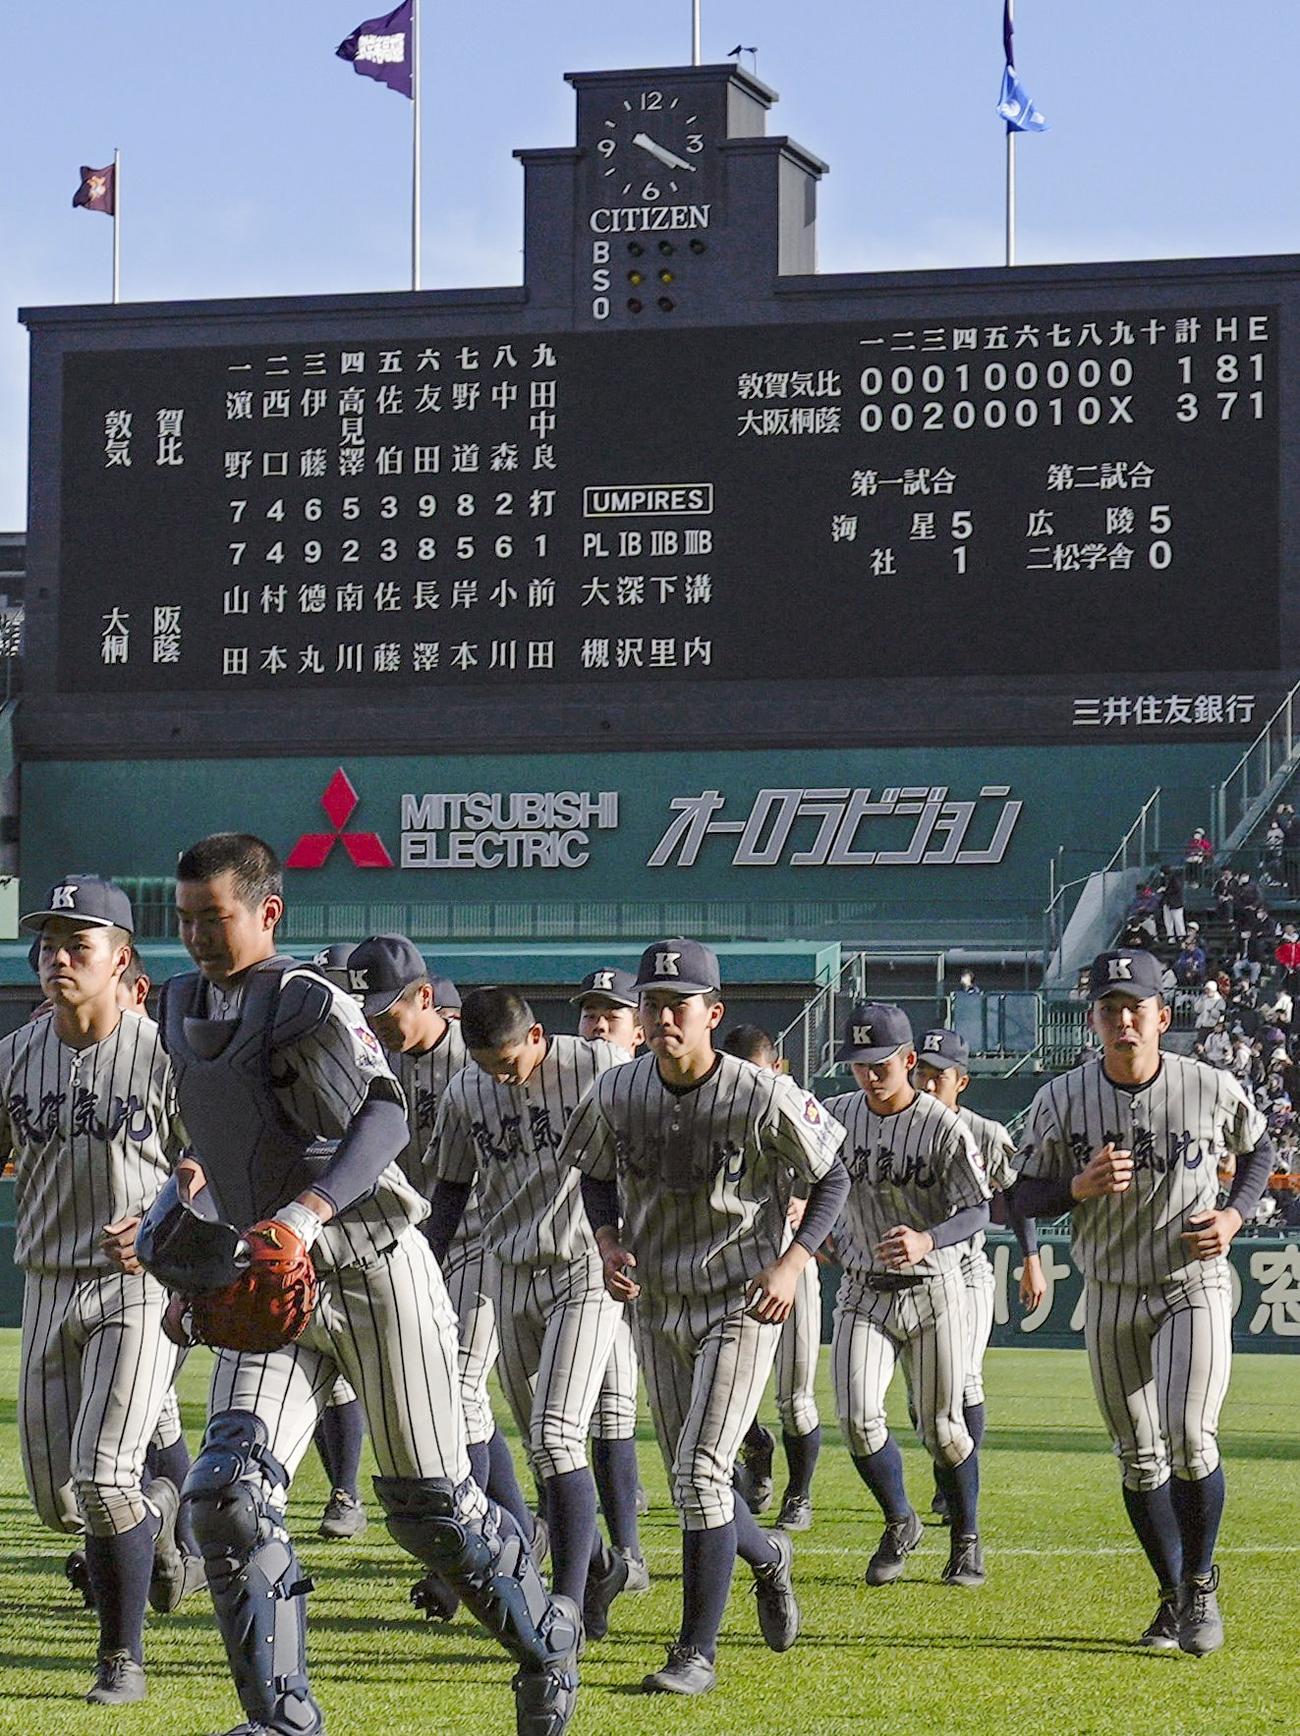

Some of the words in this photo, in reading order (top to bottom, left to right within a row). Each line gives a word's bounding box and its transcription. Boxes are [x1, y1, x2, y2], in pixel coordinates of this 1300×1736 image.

[640, 91, 663, 111] 12
[597, 139, 616, 158] 9
[686, 134, 704, 153] 3
[641, 182, 660, 201] 6
[589, 204, 711, 233] CITIZEN
[592, 240, 610, 264] B
[592, 268, 611, 292] S
[737, 369, 842, 400] 敦賀気比
[737, 406, 842, 437] 大阪桐蔭
[851, 466, 957, 497] 第一試合
[1047, 460, 1155, 491] 第二試合
[592, 490, 704, 512] UMPIRES
[951, 510, 973, 540] 5
[1149, 505, 1171, 534] 5
[583, 532, 610, 557] PL
[1026, 541, 1135, 572] 二松学舎
[1149, 540, 1172, 570] 0
[870, 548, 897, 576] 社
[952, 545, 966, 574] 1
[1072, 694, 1255, 726] 三井住友銀行
[400, 791, 619, 831] MITSUBISHI
[646, 785, 1023, 867] オーロラビジョン
[400, 831, 590, 869] ELECTRIC
[51, 885, 78, 910] K
[654, 951, 681, 977] K
[1107, 957, 1133, 980] K
[349, 969, 370, 990] K
[593, 970, 616, 990] K
[851, 1025, 873, 1045] K
[923, 1034, 943, 1052] K
